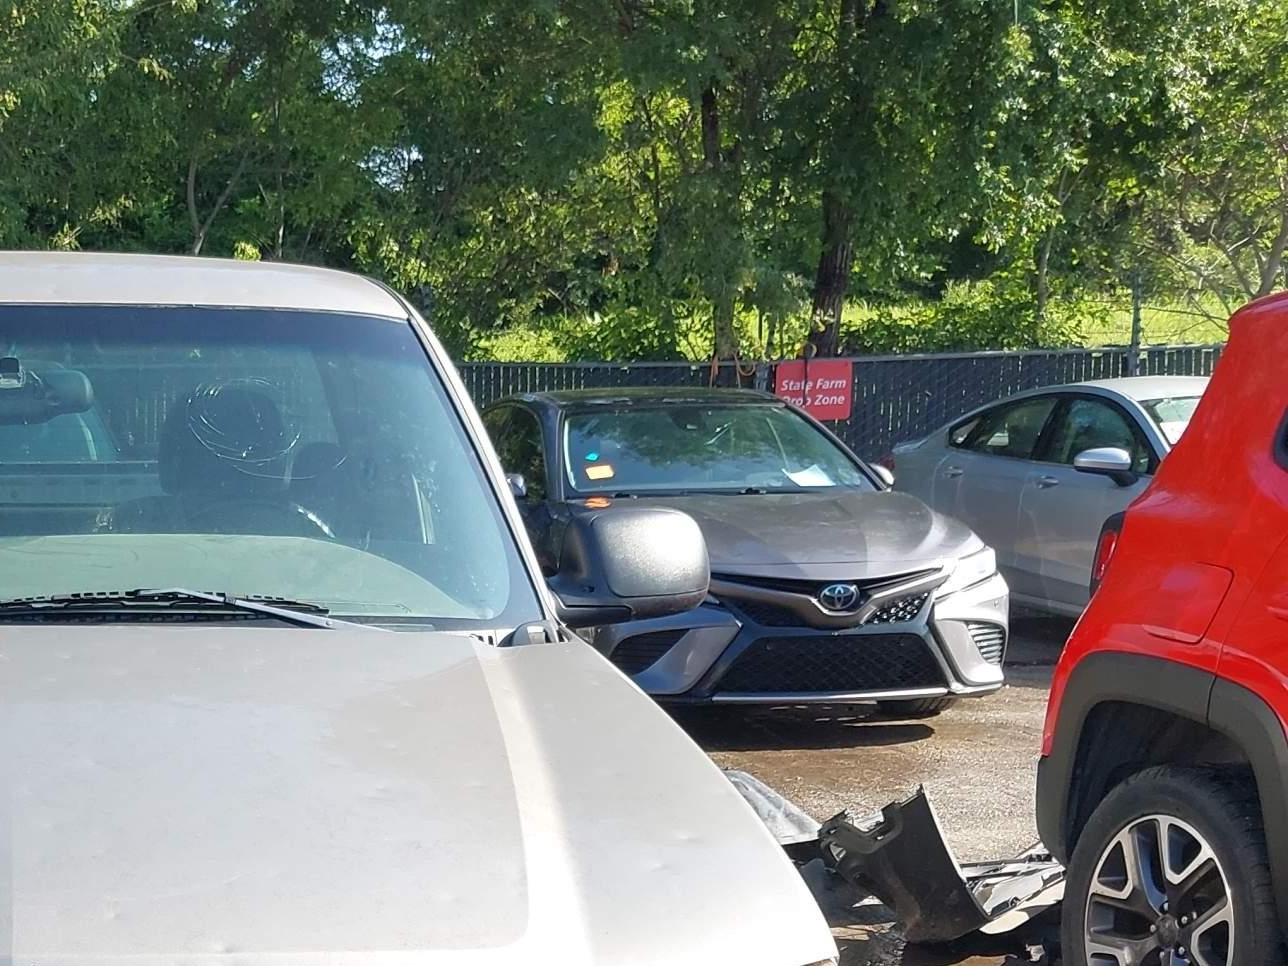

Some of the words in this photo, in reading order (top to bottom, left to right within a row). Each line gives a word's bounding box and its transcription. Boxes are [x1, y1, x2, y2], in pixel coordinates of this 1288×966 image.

[781, 379, 813, 391] State
[816, 378, 846, 390] Farm
[814, 394, 845, 406] Zone
